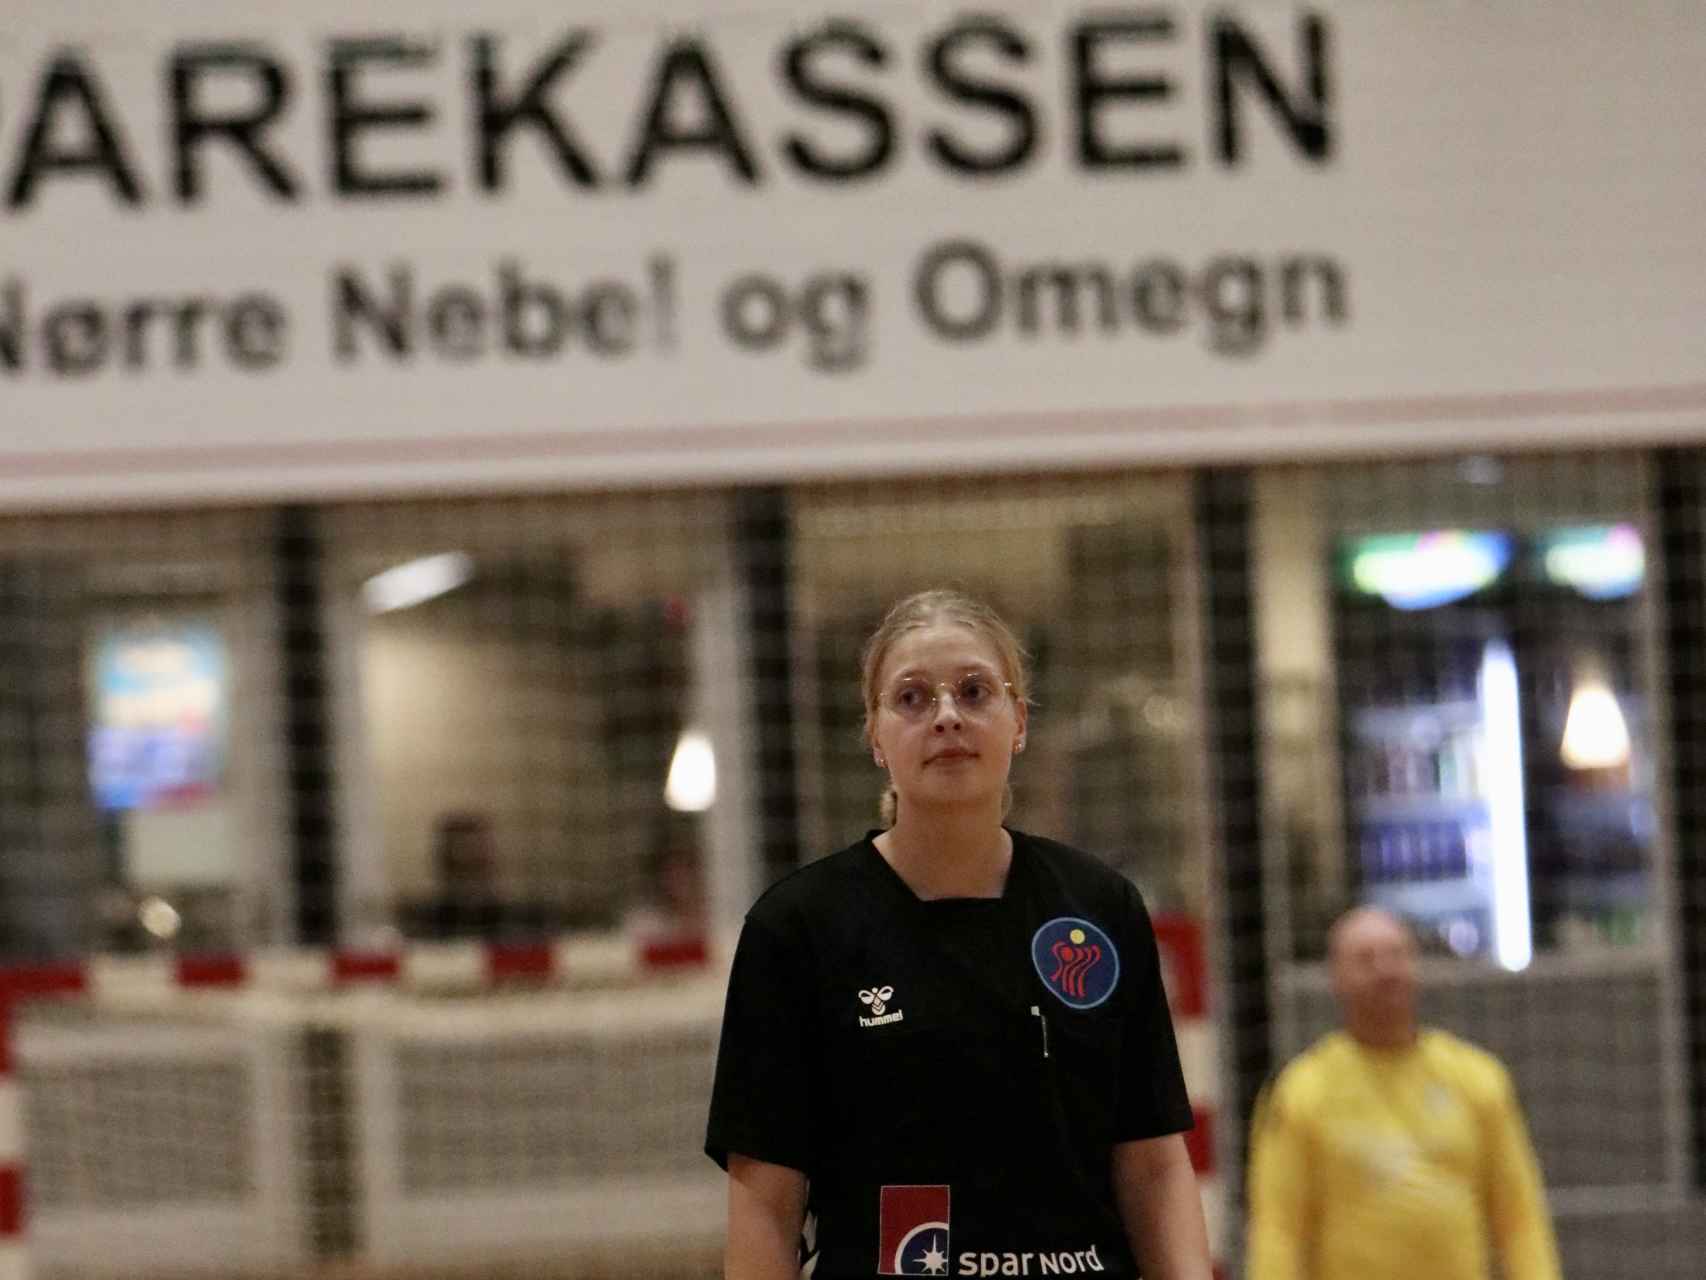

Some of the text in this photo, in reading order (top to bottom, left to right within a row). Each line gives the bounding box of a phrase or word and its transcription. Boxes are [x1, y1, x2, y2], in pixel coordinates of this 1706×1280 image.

[4, 14, 1333, 208] AREKASSEN
[328, 250, 680, 366] Nebel
[718, 270, 870, 372] og
[912, 238, 1350, 359] Omegn
[859, 1009, 903, 1027] hummel
